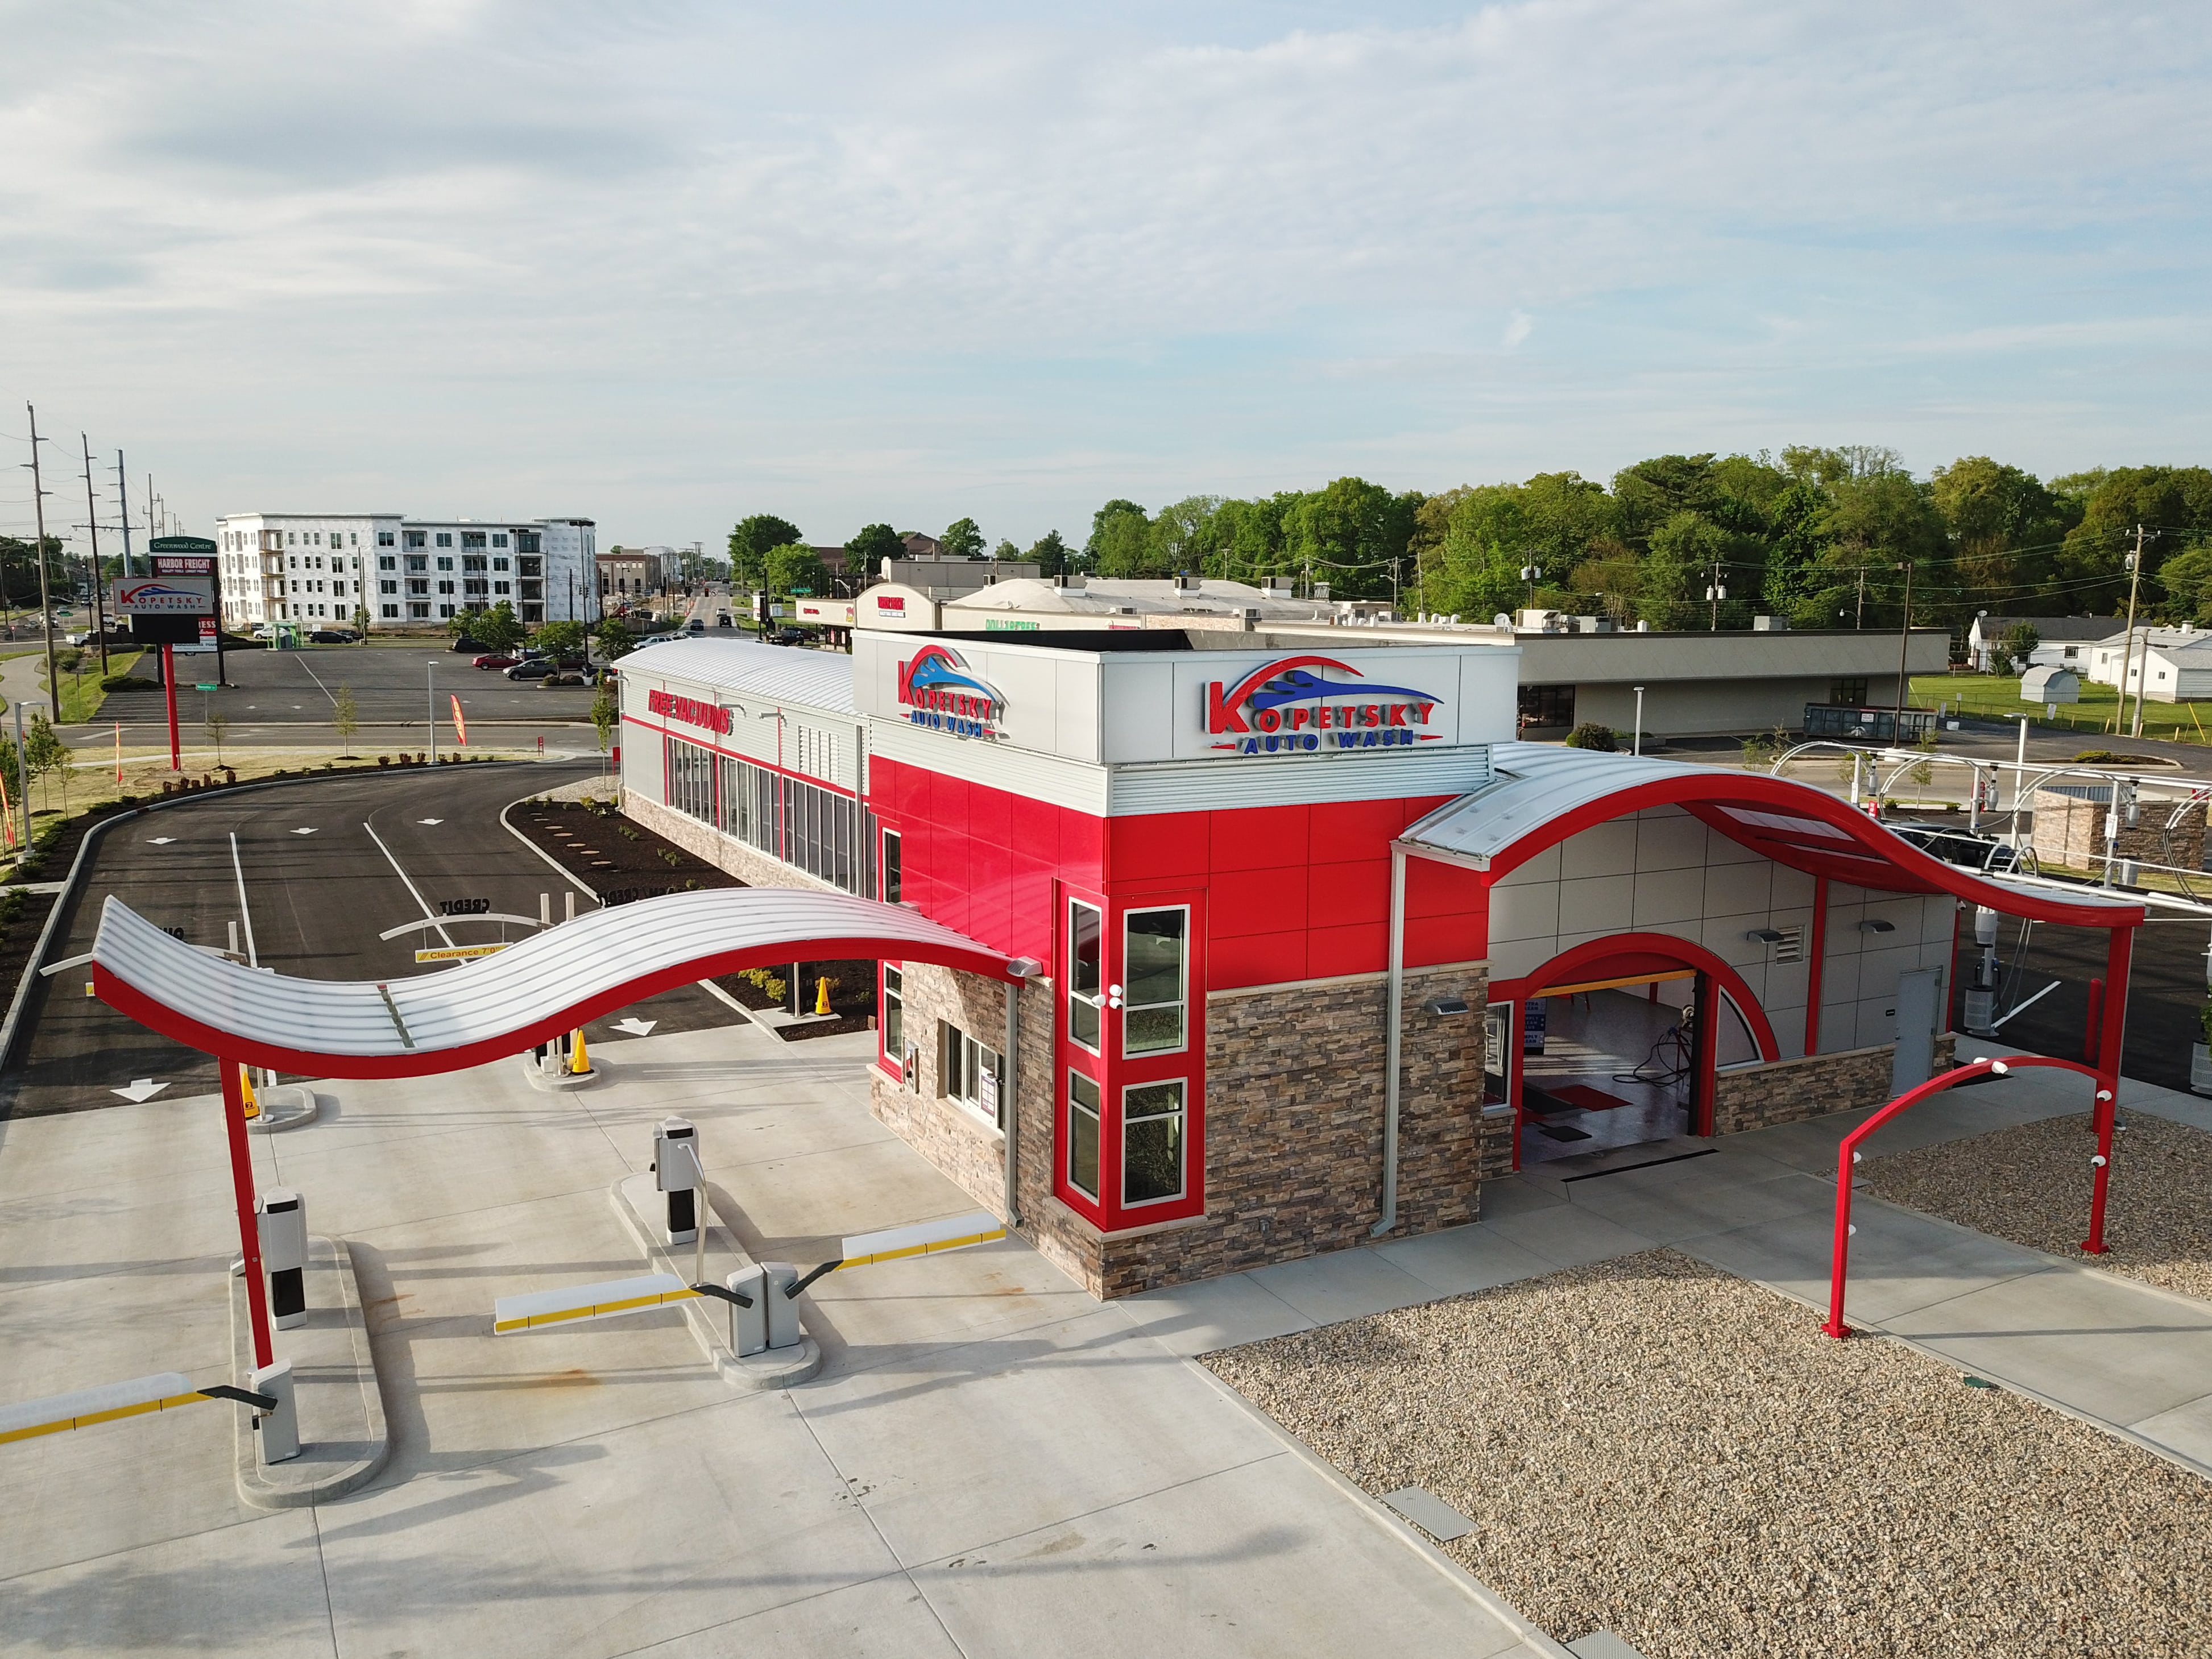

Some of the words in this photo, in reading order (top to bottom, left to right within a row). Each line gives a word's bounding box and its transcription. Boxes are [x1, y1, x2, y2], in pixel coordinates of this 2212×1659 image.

[158, 558, 183, 569] HARBOR
[184, 558, 210, 569] FREIGHT
[121, 588, 202, 604] KOPETSKY
[898, 653, 992, 720] KOPETSKY
[648, 689, 673, 717] FREE
[676, 696, 730, 735] VACUUMS
[1208, 670, 1434, 734] KOPETSKY
[911, 710, 941, 729] AUTO
[947, 716, 982, 738] WASH
[1242, 733, 1319, 754] AUTO
[1336, 728, 1414, 748] WASH
[430, 949, 479, 959] Clearance
